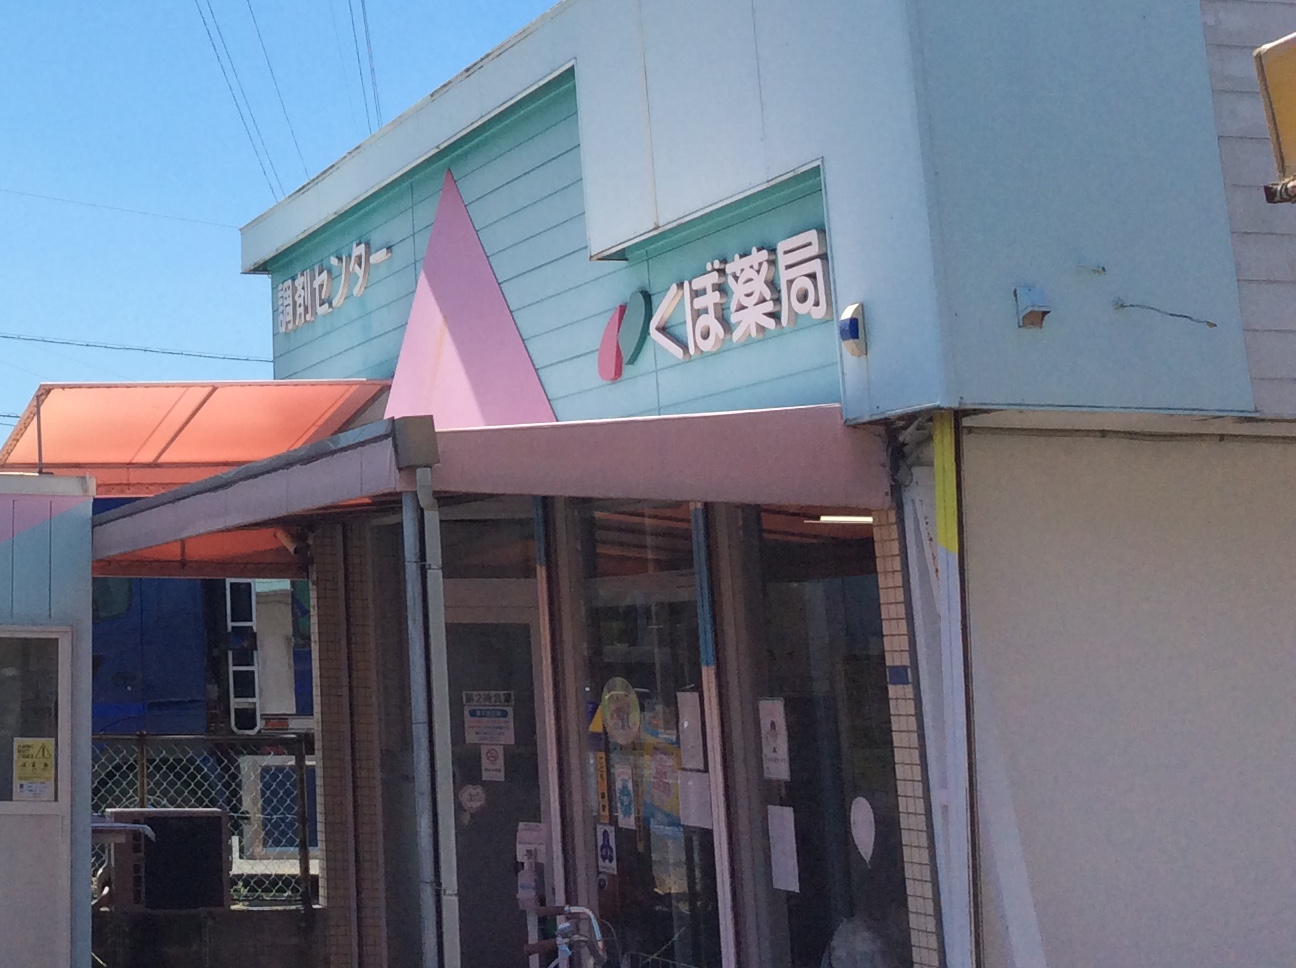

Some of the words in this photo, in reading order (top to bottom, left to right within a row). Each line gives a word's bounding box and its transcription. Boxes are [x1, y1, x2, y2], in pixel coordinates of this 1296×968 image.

[277, 240, 392, 333] 調剤センター
[649, 228, 831, 360] くぼ薬局
